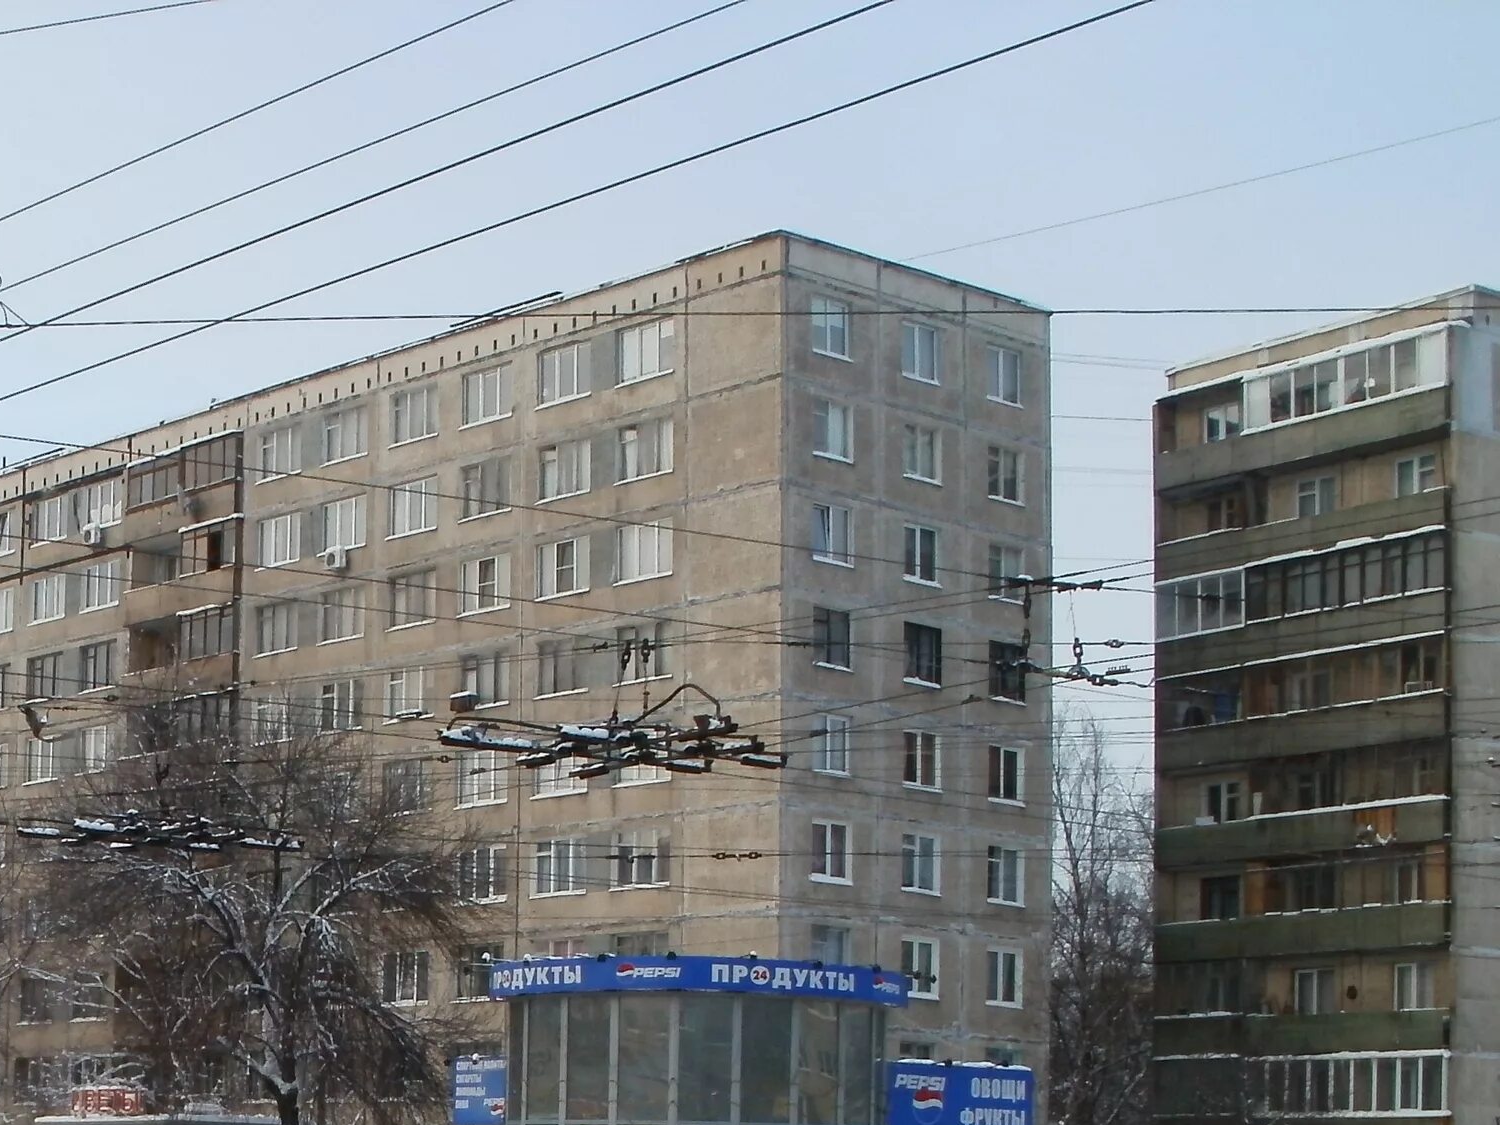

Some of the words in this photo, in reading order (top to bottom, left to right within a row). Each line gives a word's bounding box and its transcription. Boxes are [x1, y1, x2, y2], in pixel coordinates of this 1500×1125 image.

[632, 967, 681, 978] PEPSI
[895, 1073, 946, 1091] PEPSI
[970, 1077, 1026, 1103] ОВОЩИ
